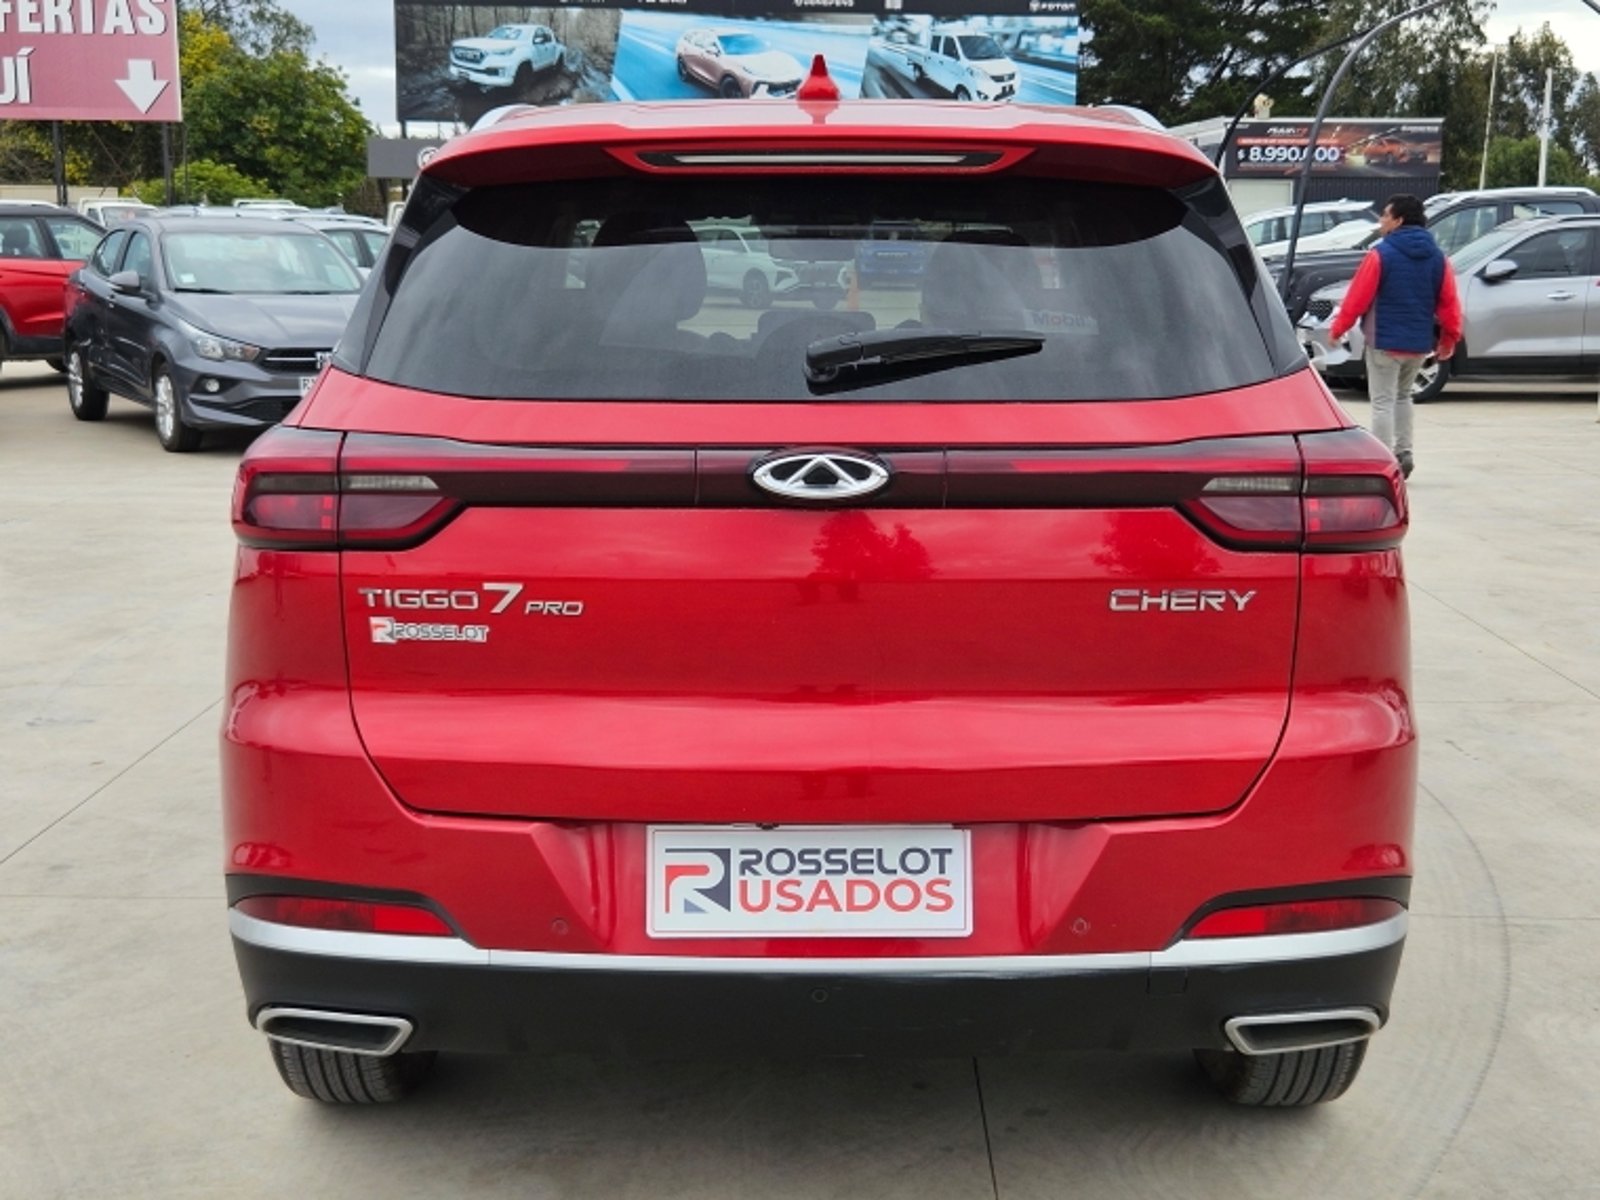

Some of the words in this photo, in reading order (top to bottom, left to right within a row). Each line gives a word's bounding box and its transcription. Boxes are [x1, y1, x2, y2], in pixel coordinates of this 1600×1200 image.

[358, 588, 479, 610] TIGGO
[482, 582, 524, 614] 7
[525, 601, 584, 616] PRO
[1109, 588, 1257, 612] CHERY
[738, 847, 953, 876] ROSSELOT
[738, 878, 954, 913] USADOS
